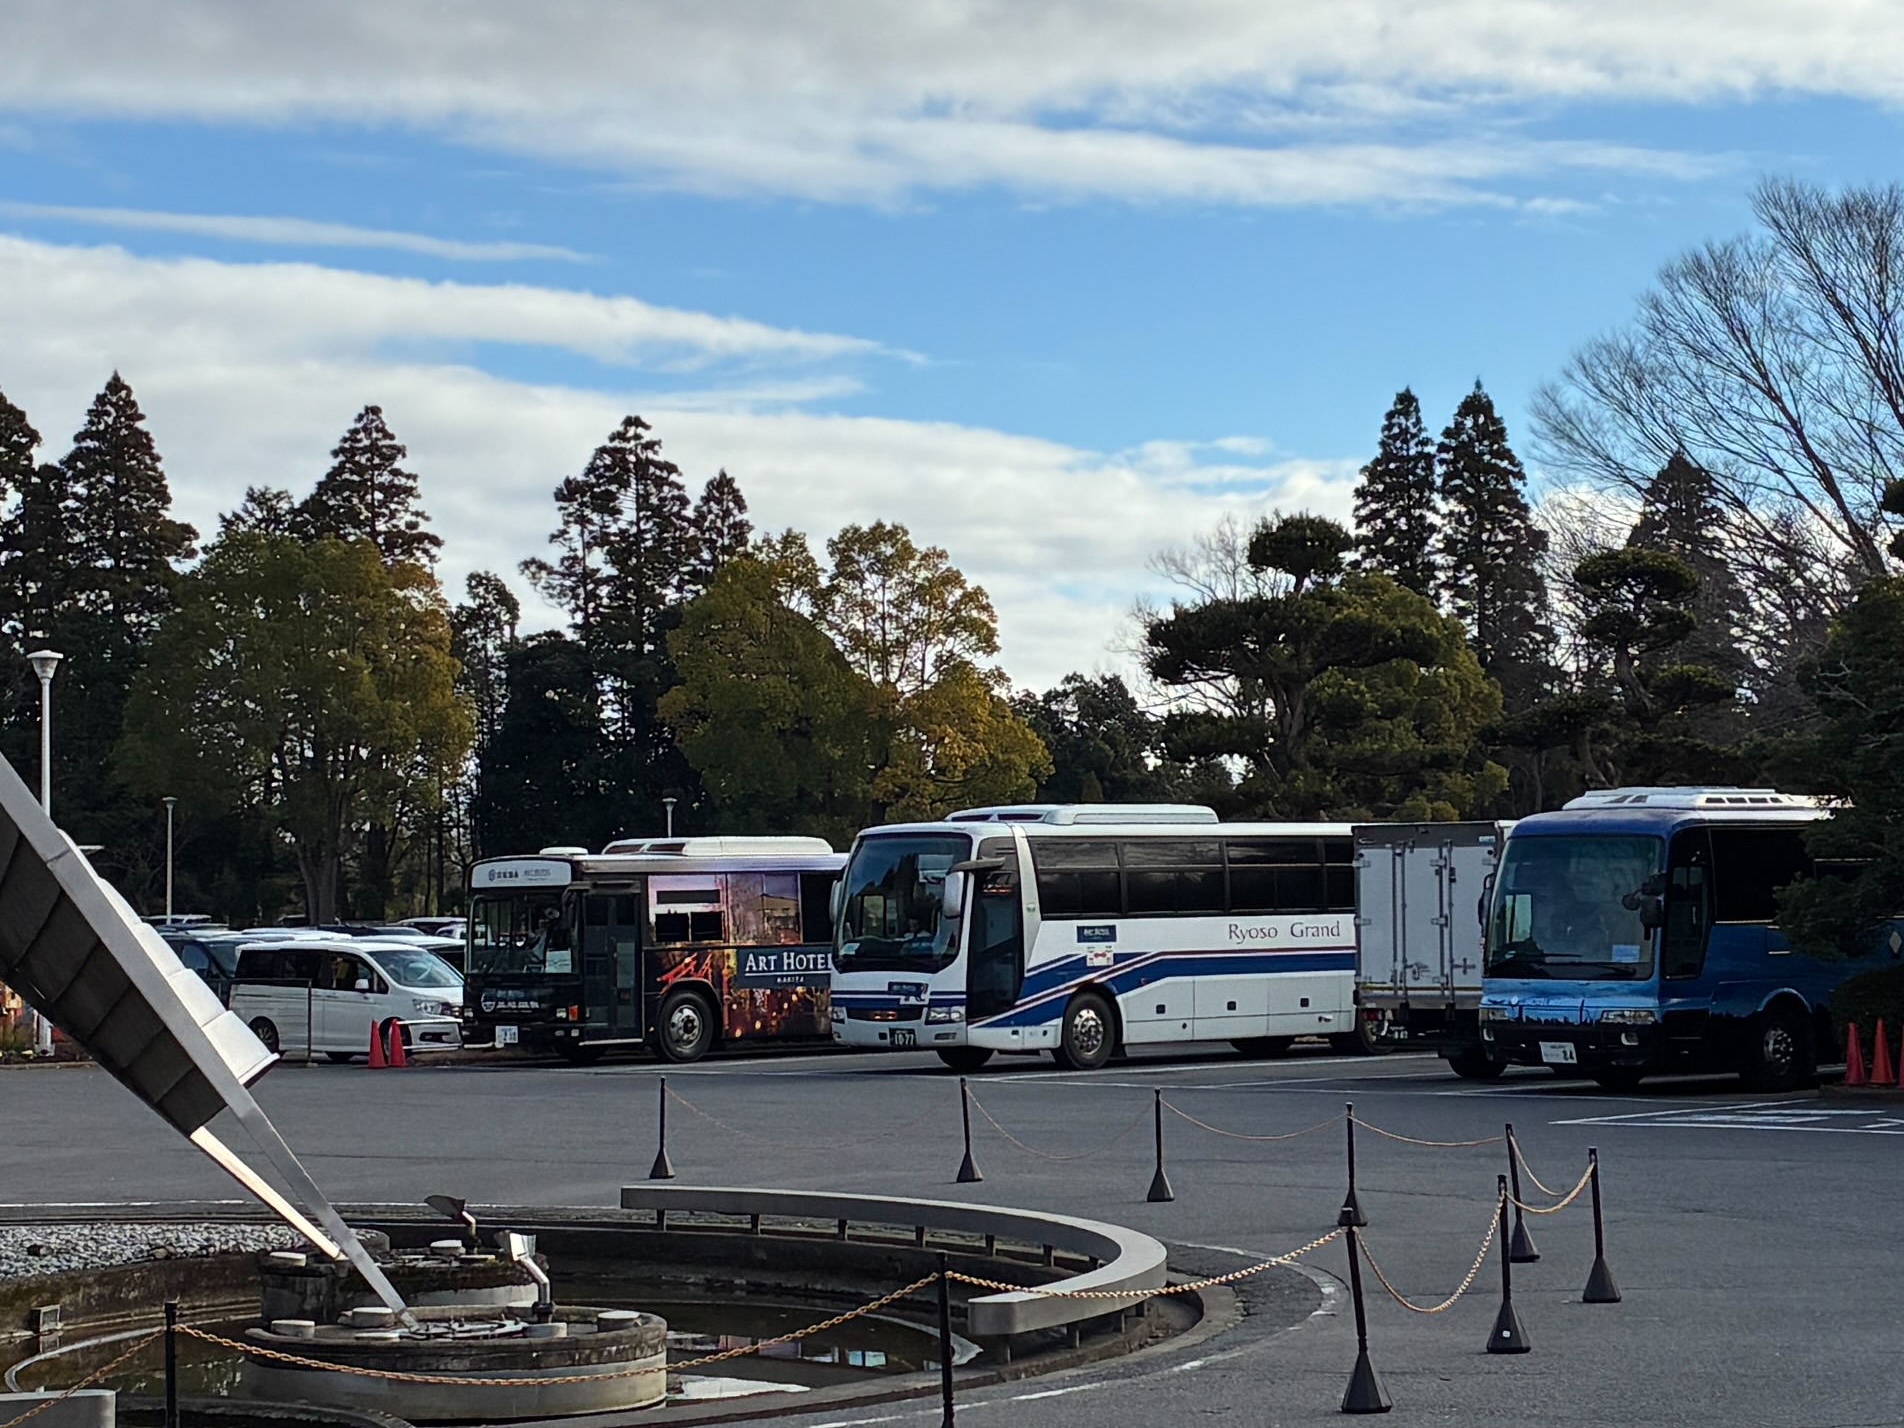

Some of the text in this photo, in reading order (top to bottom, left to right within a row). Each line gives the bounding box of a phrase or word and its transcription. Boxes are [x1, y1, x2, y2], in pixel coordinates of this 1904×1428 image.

[1228, 920, 1341, 945] Ryoso Grand
[745, 952, 778, 972] ART
